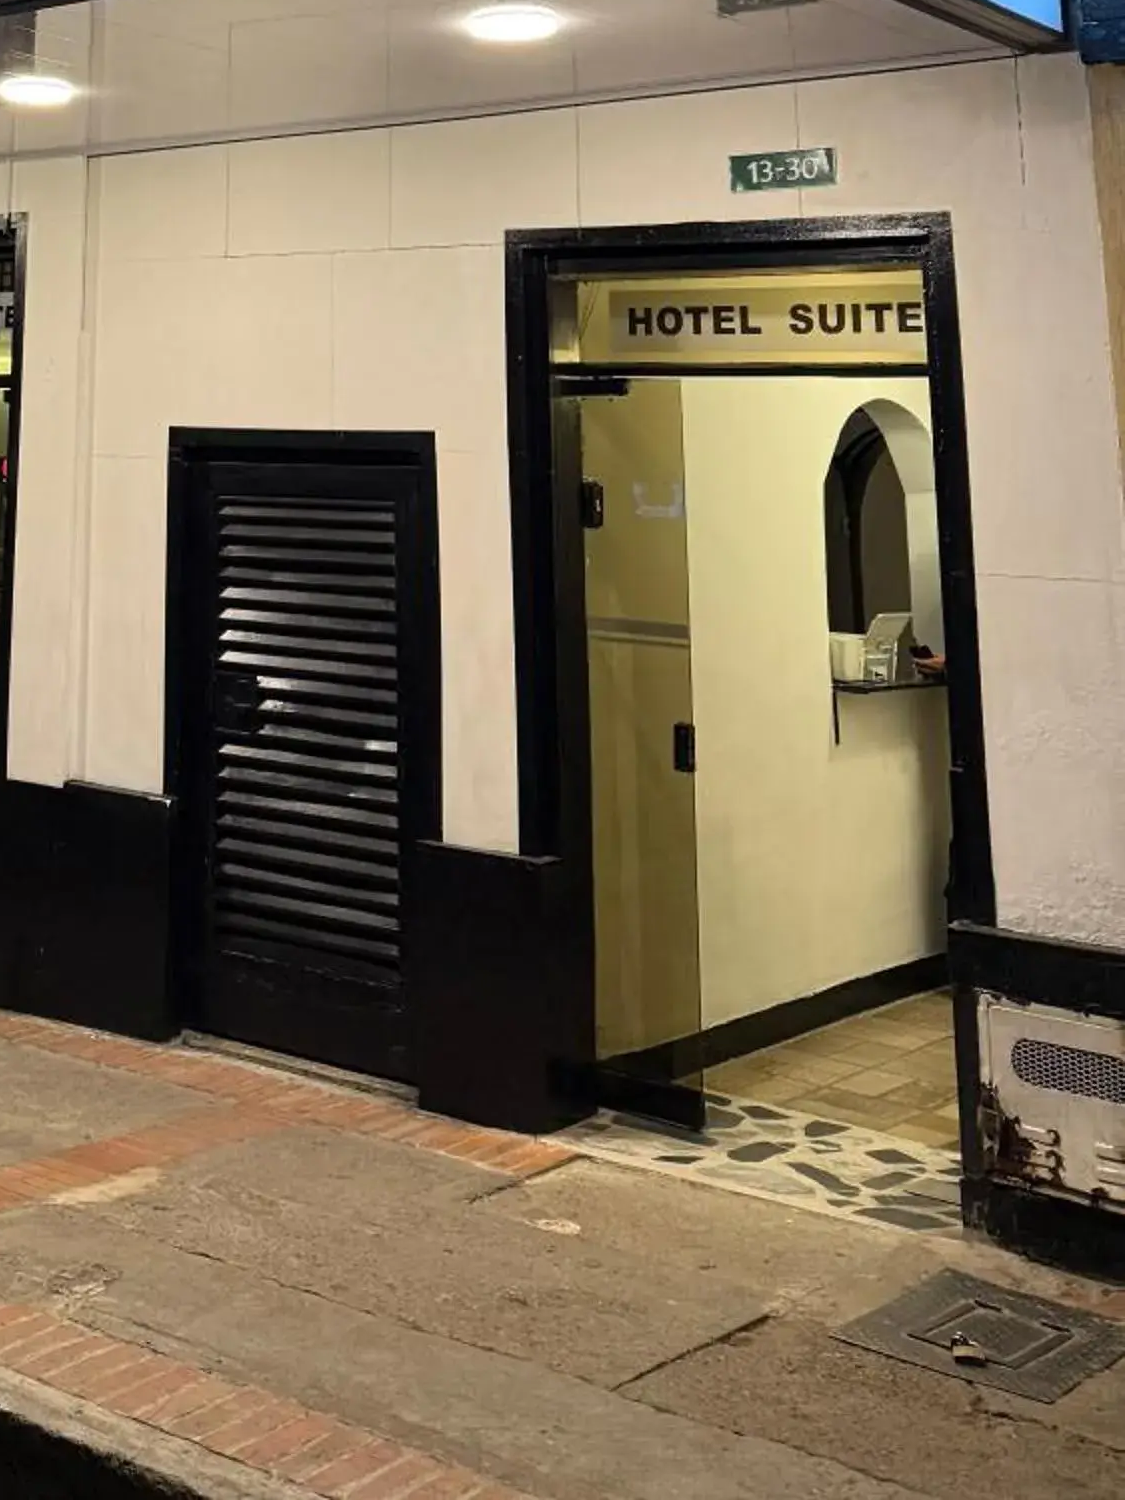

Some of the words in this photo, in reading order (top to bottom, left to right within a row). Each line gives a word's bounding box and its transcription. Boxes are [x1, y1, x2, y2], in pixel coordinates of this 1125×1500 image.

[746, 157, 819, 184] 13-30
[628, 305, 762, 337] HOTEL
[789, 301, 924, 335] SUITE
